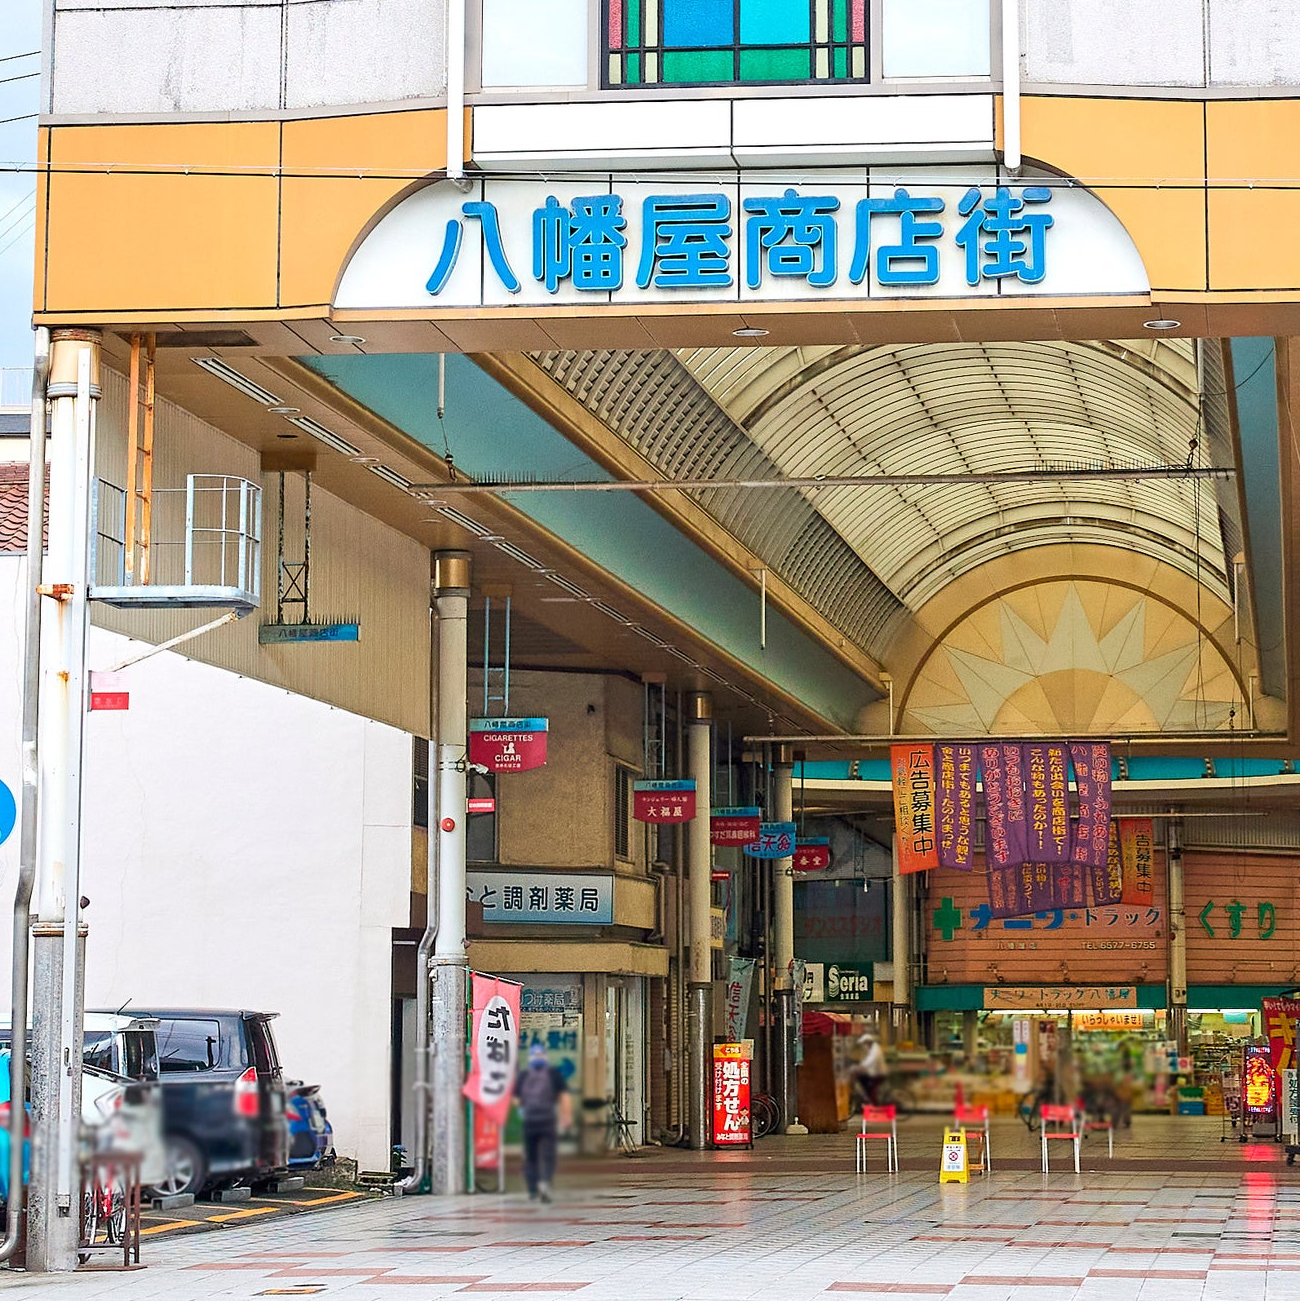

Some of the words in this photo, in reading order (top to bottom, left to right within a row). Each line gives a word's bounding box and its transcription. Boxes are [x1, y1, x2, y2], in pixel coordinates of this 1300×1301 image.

[426, 188, 1053, 295] 八幡屋商店街
[483, 734, 534, 742] CIGARETTES
[647, 806, 683, 817] 大福屋
[909, 748, 933, 857] 広告募集中
[1200, 900, 1276, 940] くすり
[1082, 941, 1098, 950] TEL
[828, 965, 869, 998] Seria
[1081, 1013, 1142, 1027] いらっしゃいませ!
[722, 1061, 741, 1132] 処方せん
